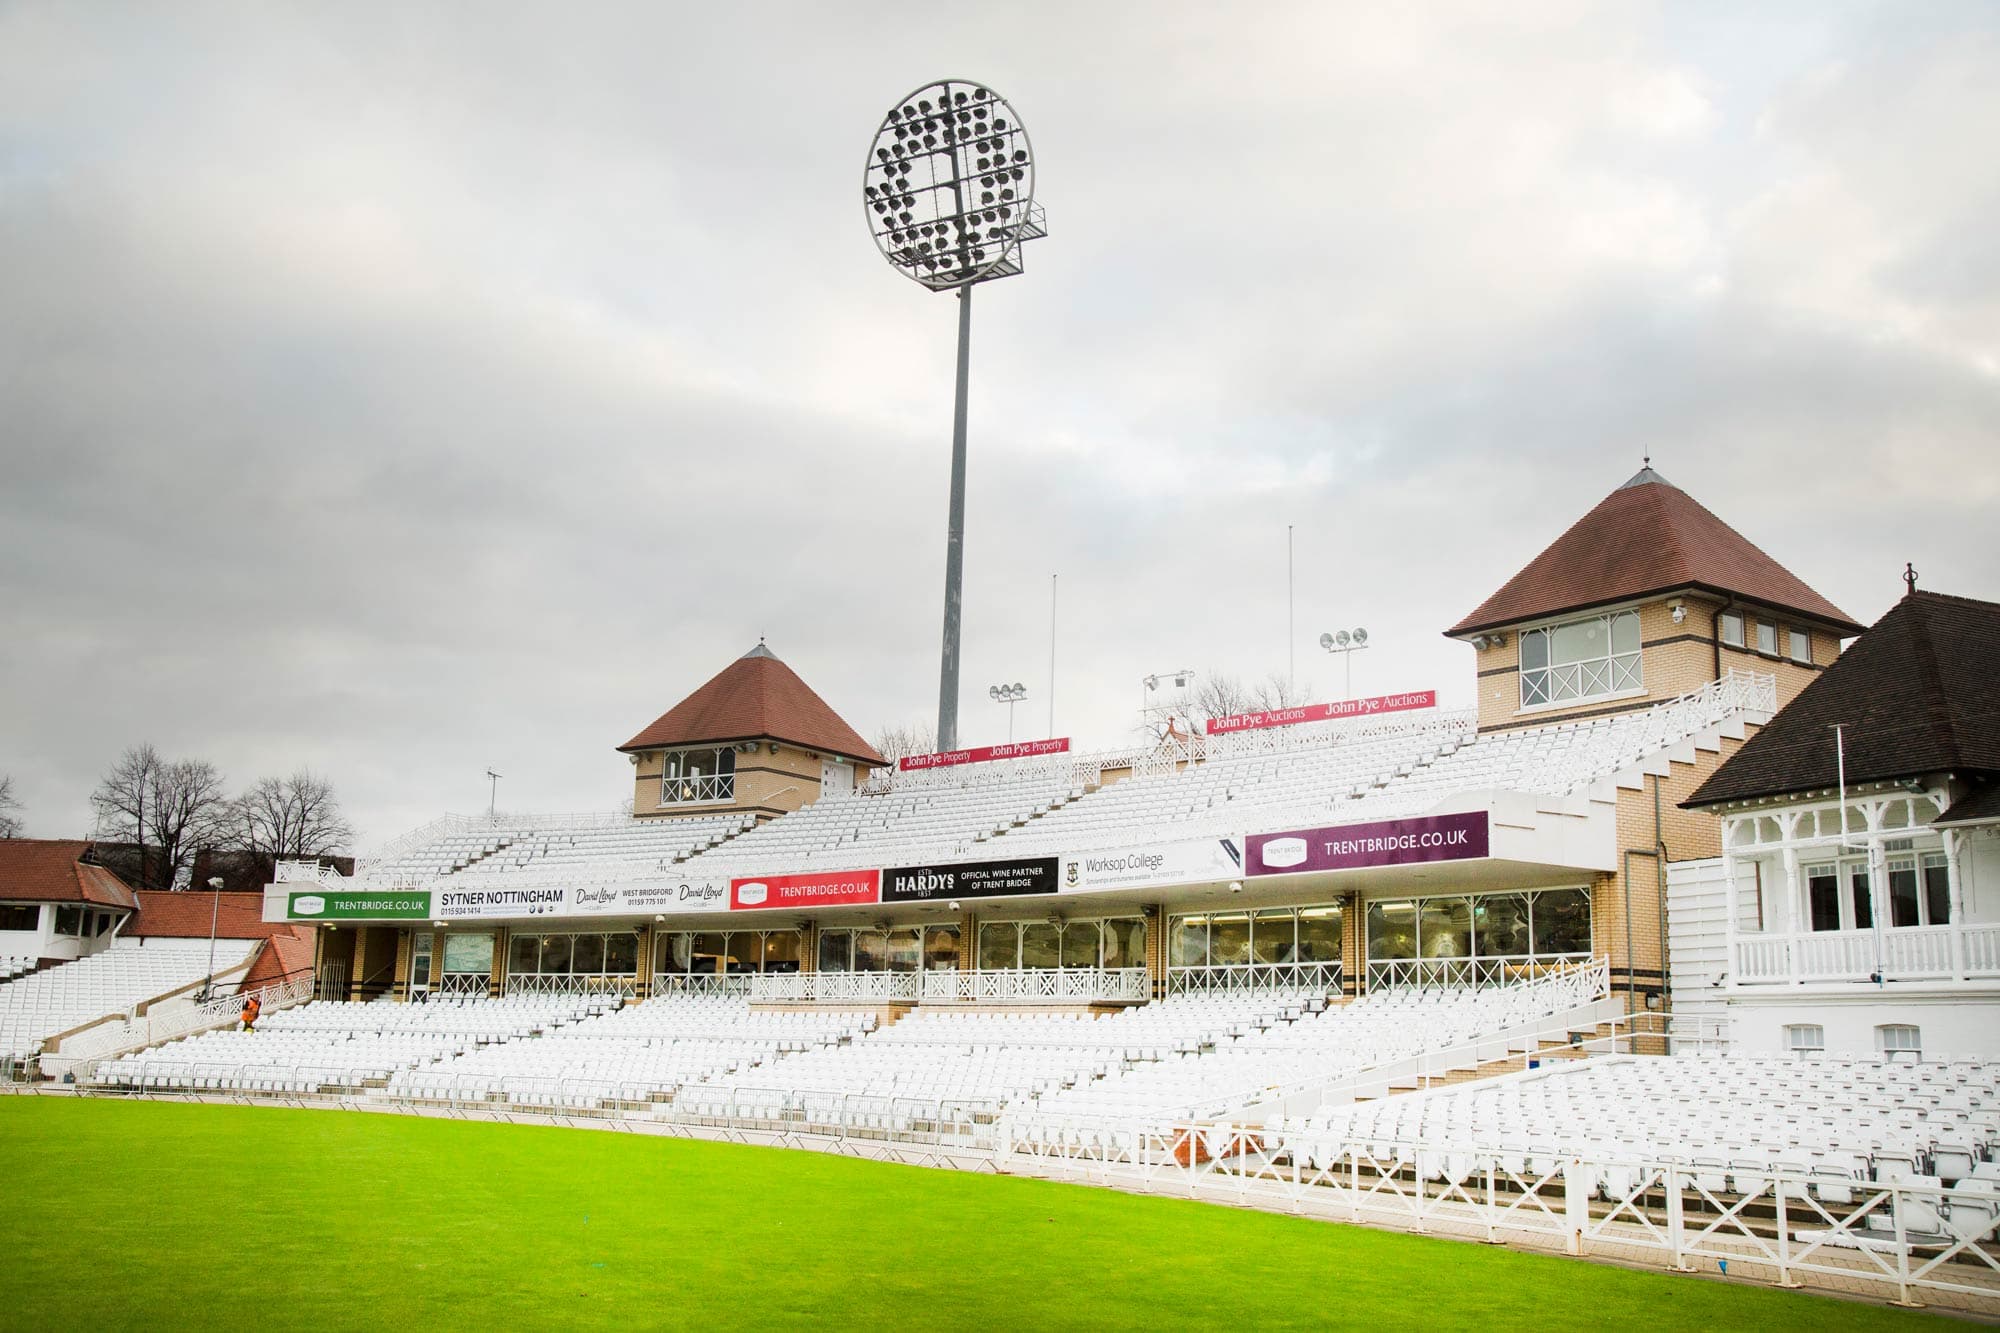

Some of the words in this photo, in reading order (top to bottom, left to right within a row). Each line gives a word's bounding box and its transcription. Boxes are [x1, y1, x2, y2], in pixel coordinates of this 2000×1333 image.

[1325, 701, 1355, 715] John
[1357, 698, 1380, 713] Pye
[1382, 693, 1428, 708] Auctions
[1213, 717, 1241, 730] John
[1242, 713, 1263, 728] Pye
[1265, 709, 1306, 723] Auctions
[990, 745, 1012, 757] John
[1013, 743, 1030, 756] Pye
[1032, 740, 1063, 754] Property
[906, 757, 927, 768] John
[927, 754, 942, 766] Pye
[943, 751, 971, 764] Property
[1325, 829, 1469, 856] TRENTBRIDGE.CO.UK
[1086, 856, 1126, 873] Worksop
[1127, 853, 1164, 869] College
[961, 871, 991, 880] OFFICIAL
[992, 869, 1011, 878] WINE
[1012, 867, 1044, 876] PARTNER
[622, 889, 638, 897] WEST
[638, 888, 673, 897] BRIDGFORD
[679, 884, 703, 901] David
[703, 882, 724, 900] Lloyd
[779, 882, 870, 897] TRENTBRIDGE.CO.UK
[971, 882, 981, 890] OF
[983, 880, 1005, 889] TRENT
[1006, 878, 1032, 887] BRIDGE
[441, 892, 485, 906] SYTNER
[486, 889, 564, 904] NOTTINGHAM
[576, 888, 599, 905] David
[598, 887, 618, 904] Lloyd
[627, 898, 645, 906] 01159
[334, 900, 424, 910] TRENTBRIDGE.CO.UK
[467, 907, 481, 915] 1414
